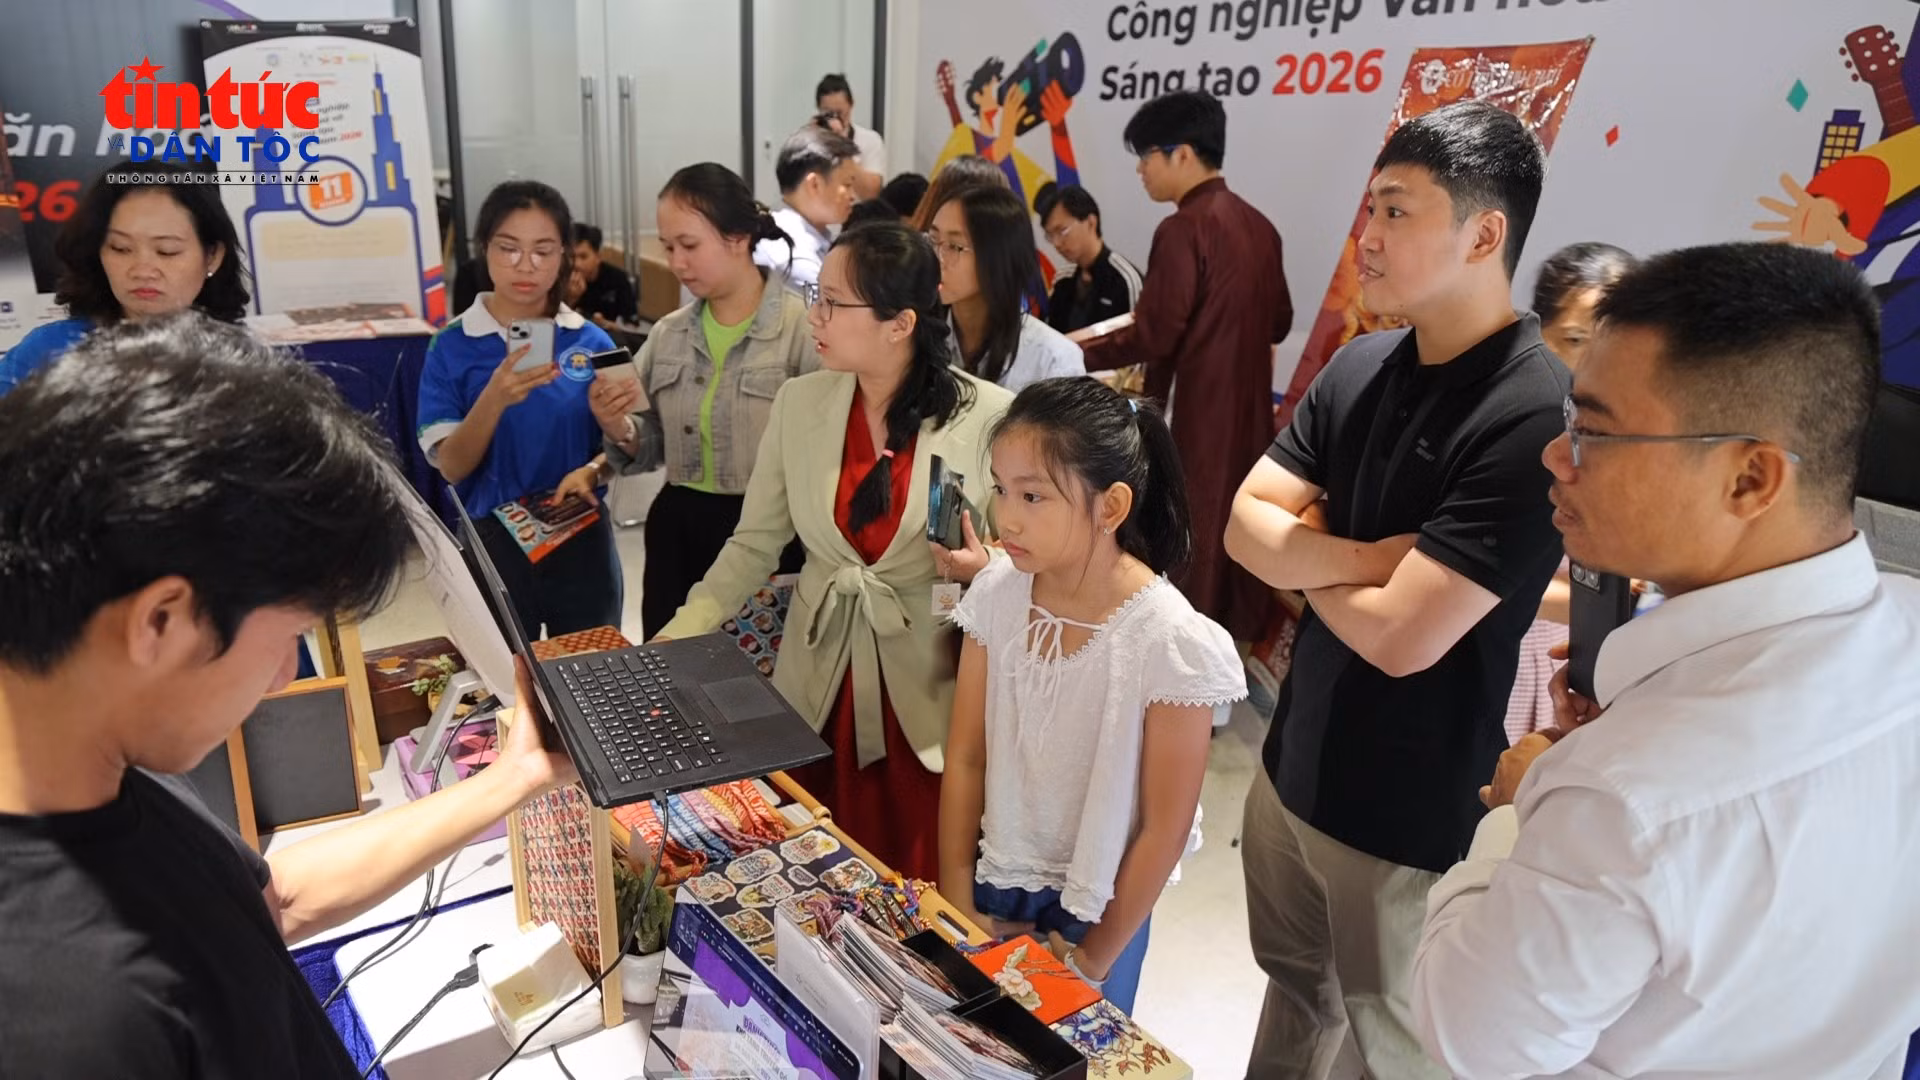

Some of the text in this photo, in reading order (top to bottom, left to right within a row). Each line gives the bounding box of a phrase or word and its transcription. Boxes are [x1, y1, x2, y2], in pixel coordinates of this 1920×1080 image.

[1107, 1, 1197, 46] Công
[1272, 48, 1385, 96] 2026
[3, 112, 76, 157] ăn
[13, 179, 81, 223] 26
